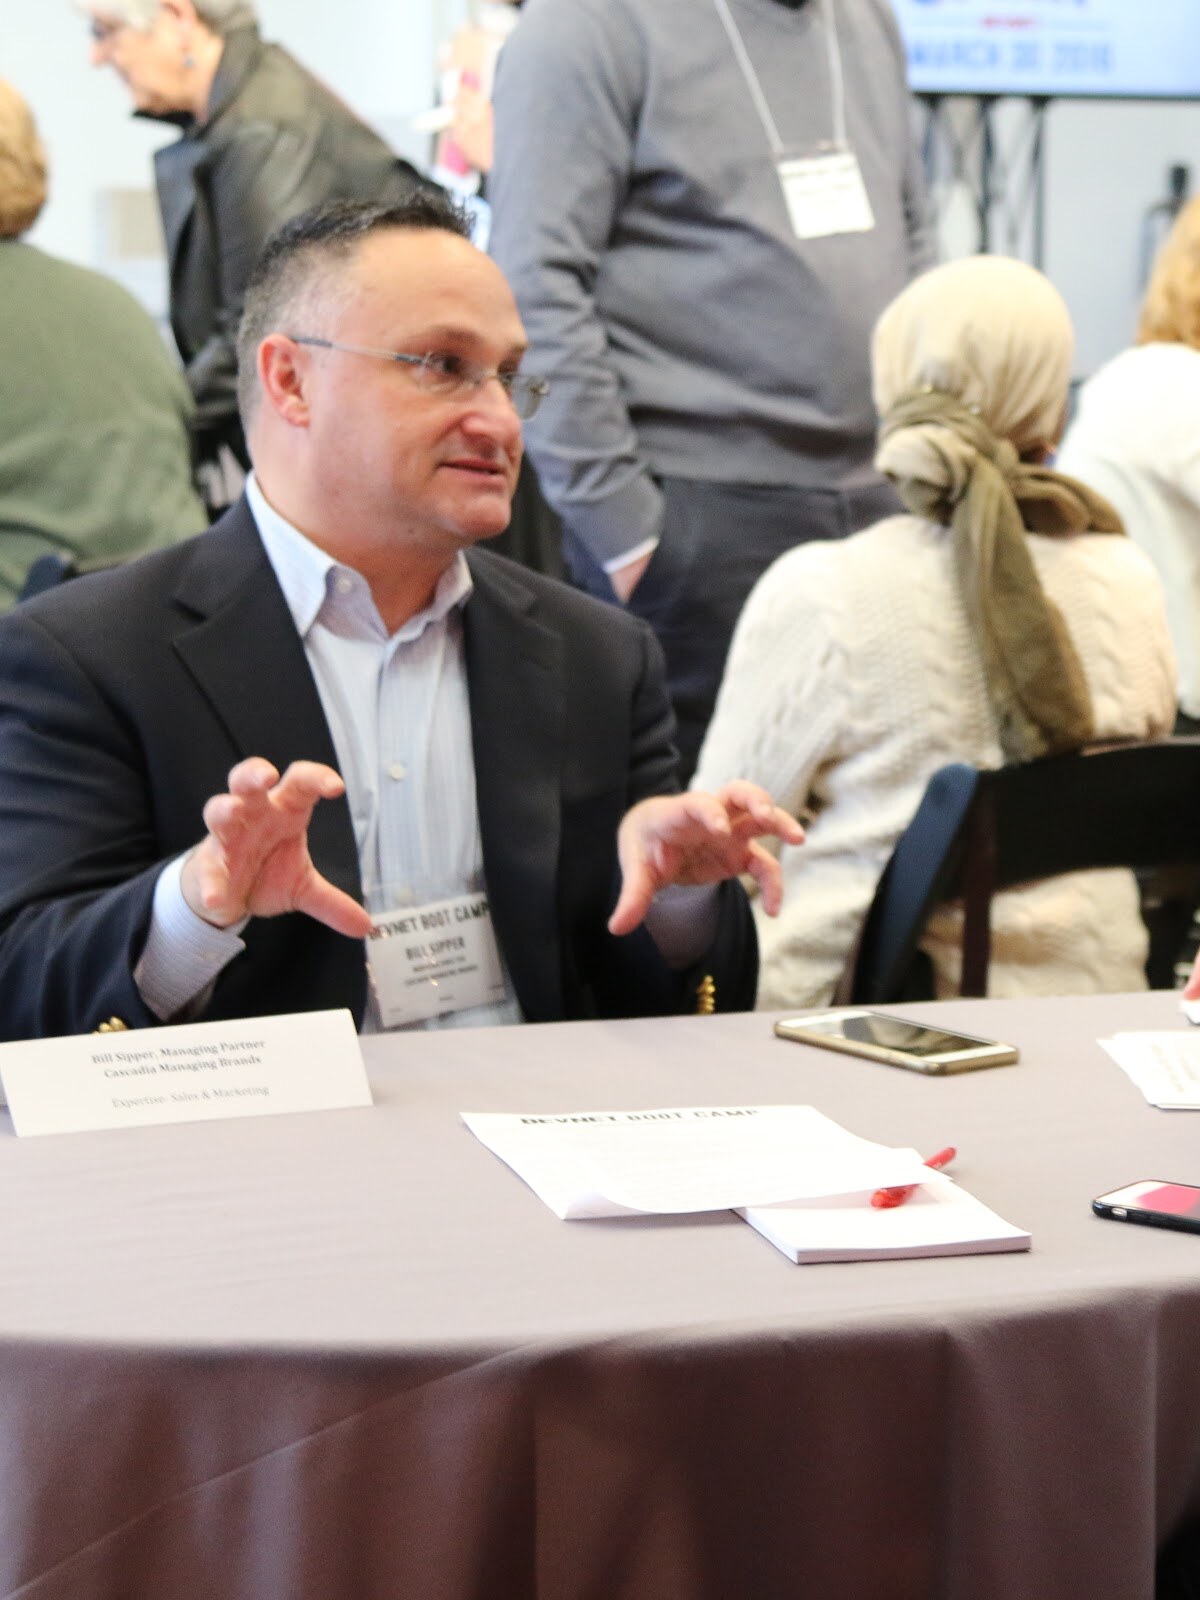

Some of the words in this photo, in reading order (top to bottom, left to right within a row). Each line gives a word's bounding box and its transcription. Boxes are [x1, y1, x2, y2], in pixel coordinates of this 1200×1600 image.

[420, 908, 451, 931] BOOT
[454, 900, 490, 923] CAMP
[405, 944, 430, 961] BILL
[429, 936, 465, 955] SIPPER
[91, 1053, 113, 1064] Bill
[115, 1050, 158, 1064] Sipper,
[159, 1044, 219, 1058] Managing
[219, 1040, 266, 1052] Partner
[104, 1065, 157, 1079] Cascadia
[159, 1059, 218, 1073] Managing
[218, 1054, 262, 1068] Brands
[170, 1090, 198, 1103] Sales
[200, 1089, 210, 1100] &
[212, 1085, 270, 1099] Marketing
[627, 1112, 683, 1121] BOOT
[694, 1109, 759, 1118] CAMP
